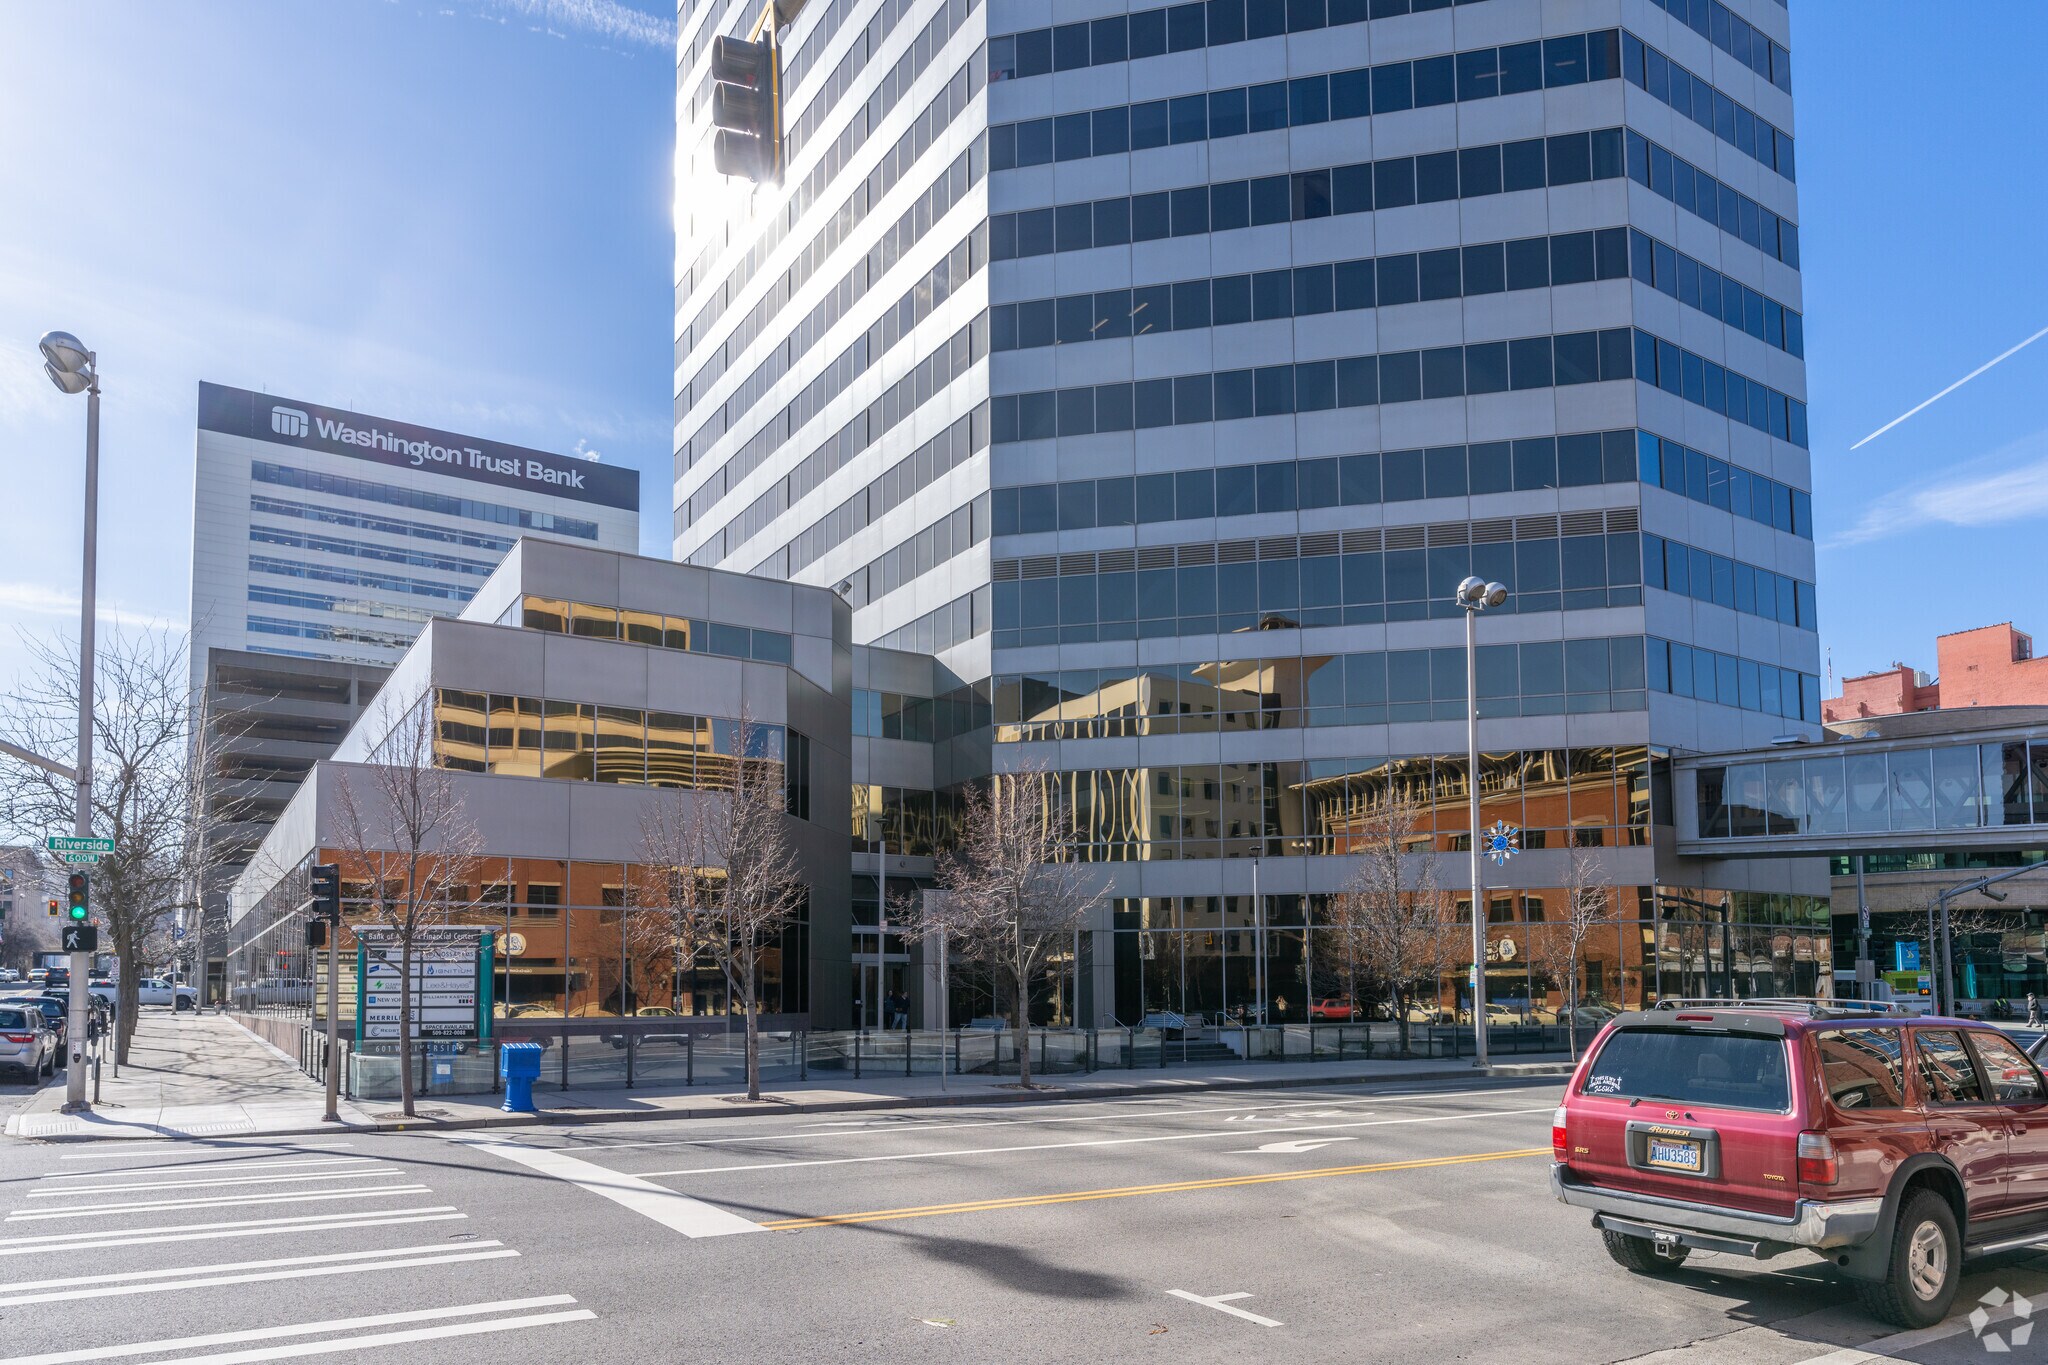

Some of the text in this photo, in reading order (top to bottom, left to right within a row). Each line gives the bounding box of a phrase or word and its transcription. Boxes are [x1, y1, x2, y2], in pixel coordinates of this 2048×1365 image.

[315, 417, 586, 490] Washington Trust Bank
[54, 838, 110, 851] Riverside
[68, 854, 95, 862] 600W
[375, 1045, 391, 1053] 601
[1651, 1147, 1697, 1165] AHU3589
[1763, 1173, 1785, 1182] TOYOTA
